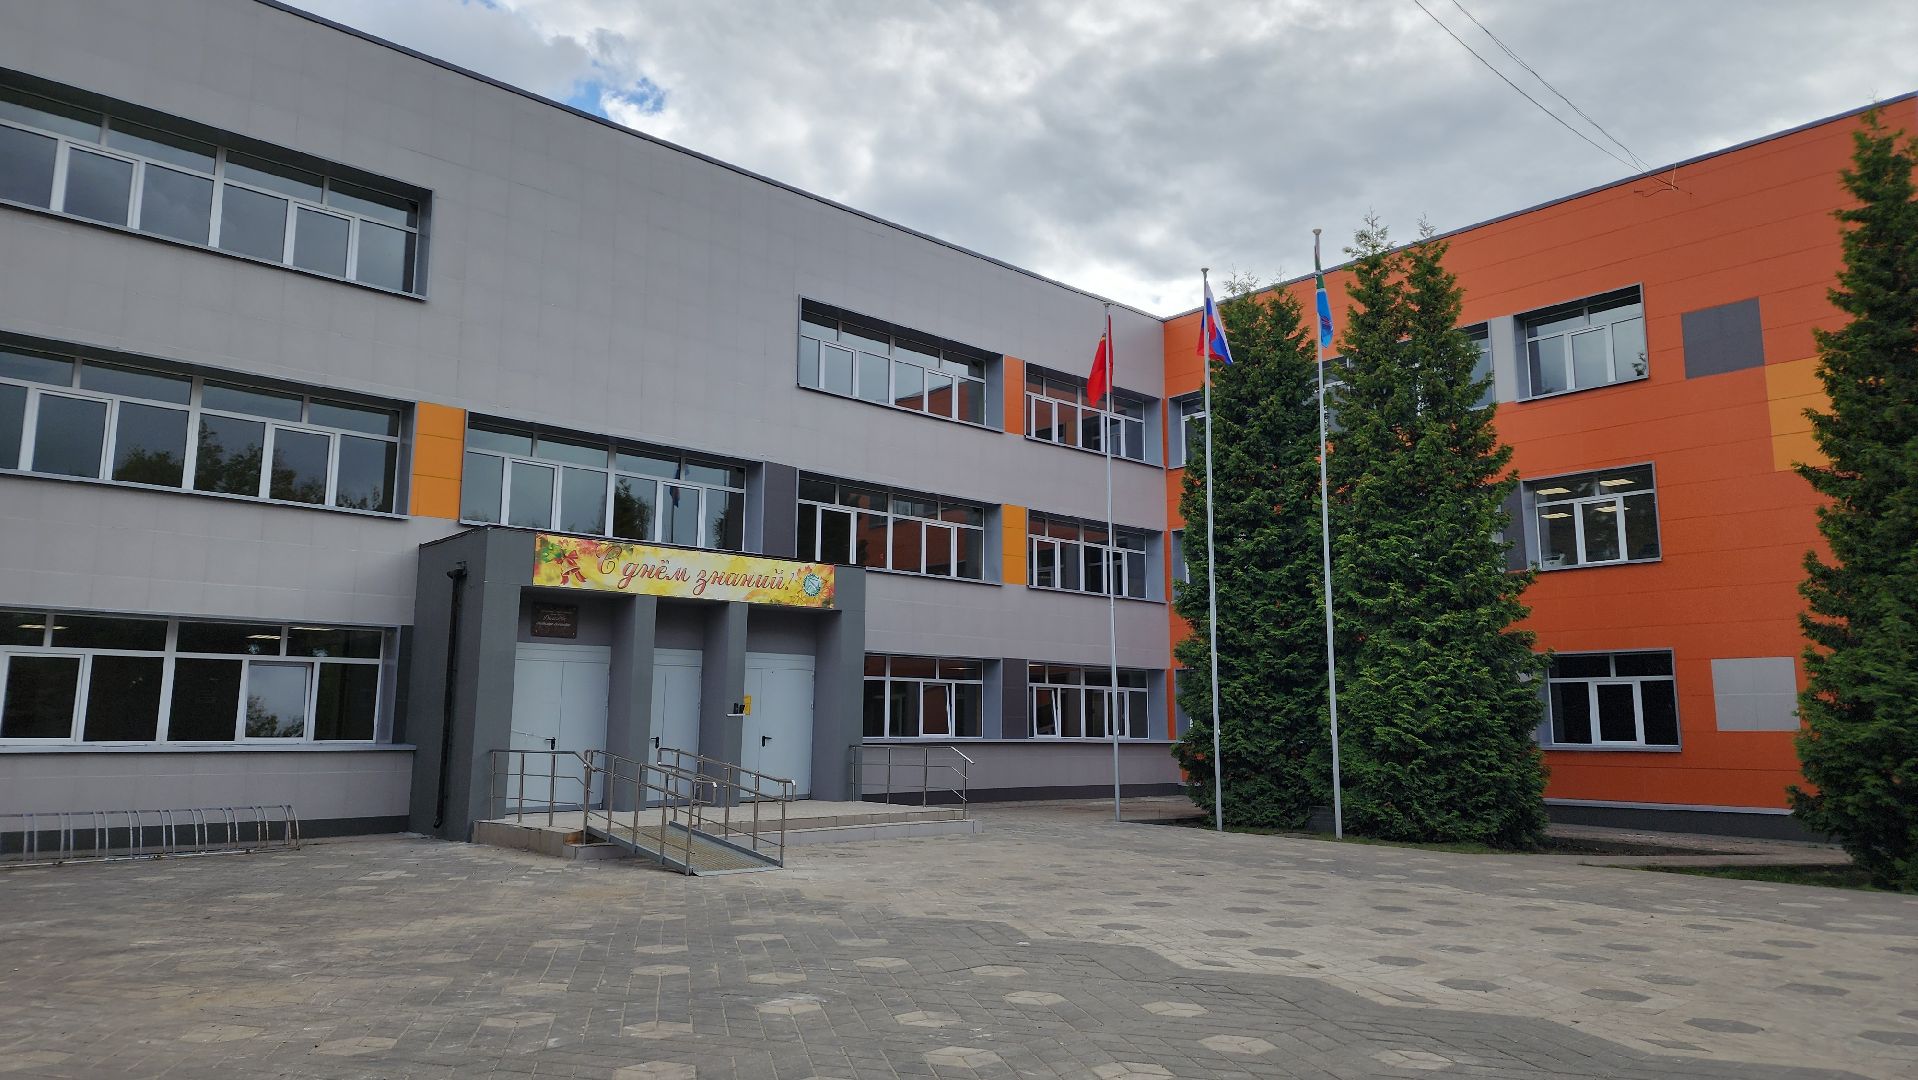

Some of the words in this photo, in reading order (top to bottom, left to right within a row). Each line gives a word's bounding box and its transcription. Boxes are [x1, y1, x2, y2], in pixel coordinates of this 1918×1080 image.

[595, 545, 622, 575] С
[617, 559, 691, 590] днём
[692, 568, 795, 596] знаний!
